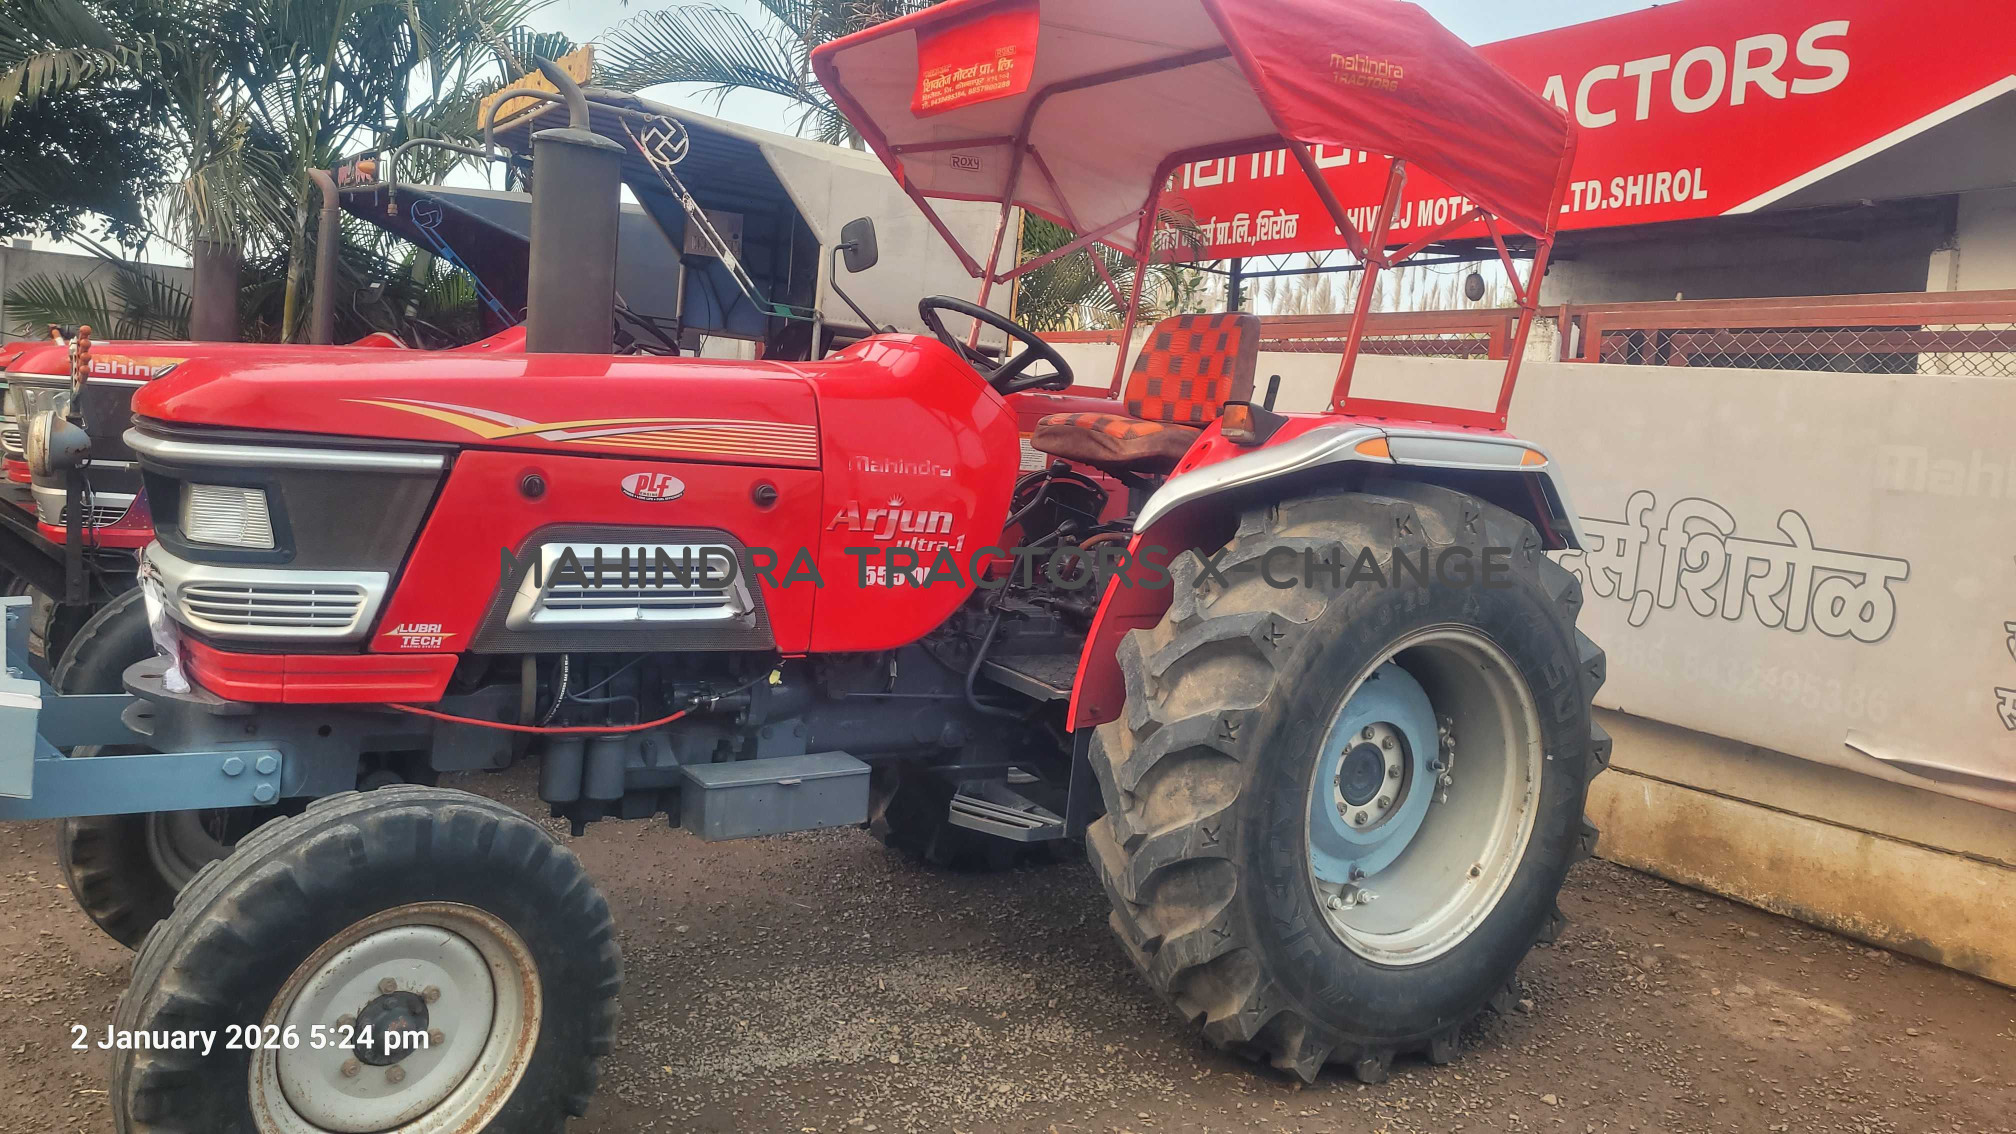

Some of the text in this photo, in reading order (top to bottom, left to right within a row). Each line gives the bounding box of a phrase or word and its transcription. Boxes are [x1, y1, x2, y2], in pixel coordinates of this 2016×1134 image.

[1330, 54, 1404, 79] mahindra
[1541, 20, 1851, 129] ACTORS
[1333, 71, 1398, 92] TRACTORS
[826, 495, 953, 540] Arjun
[399, 623, 443, 633] LUBRI
[402, 636, 443, 646] TECH
